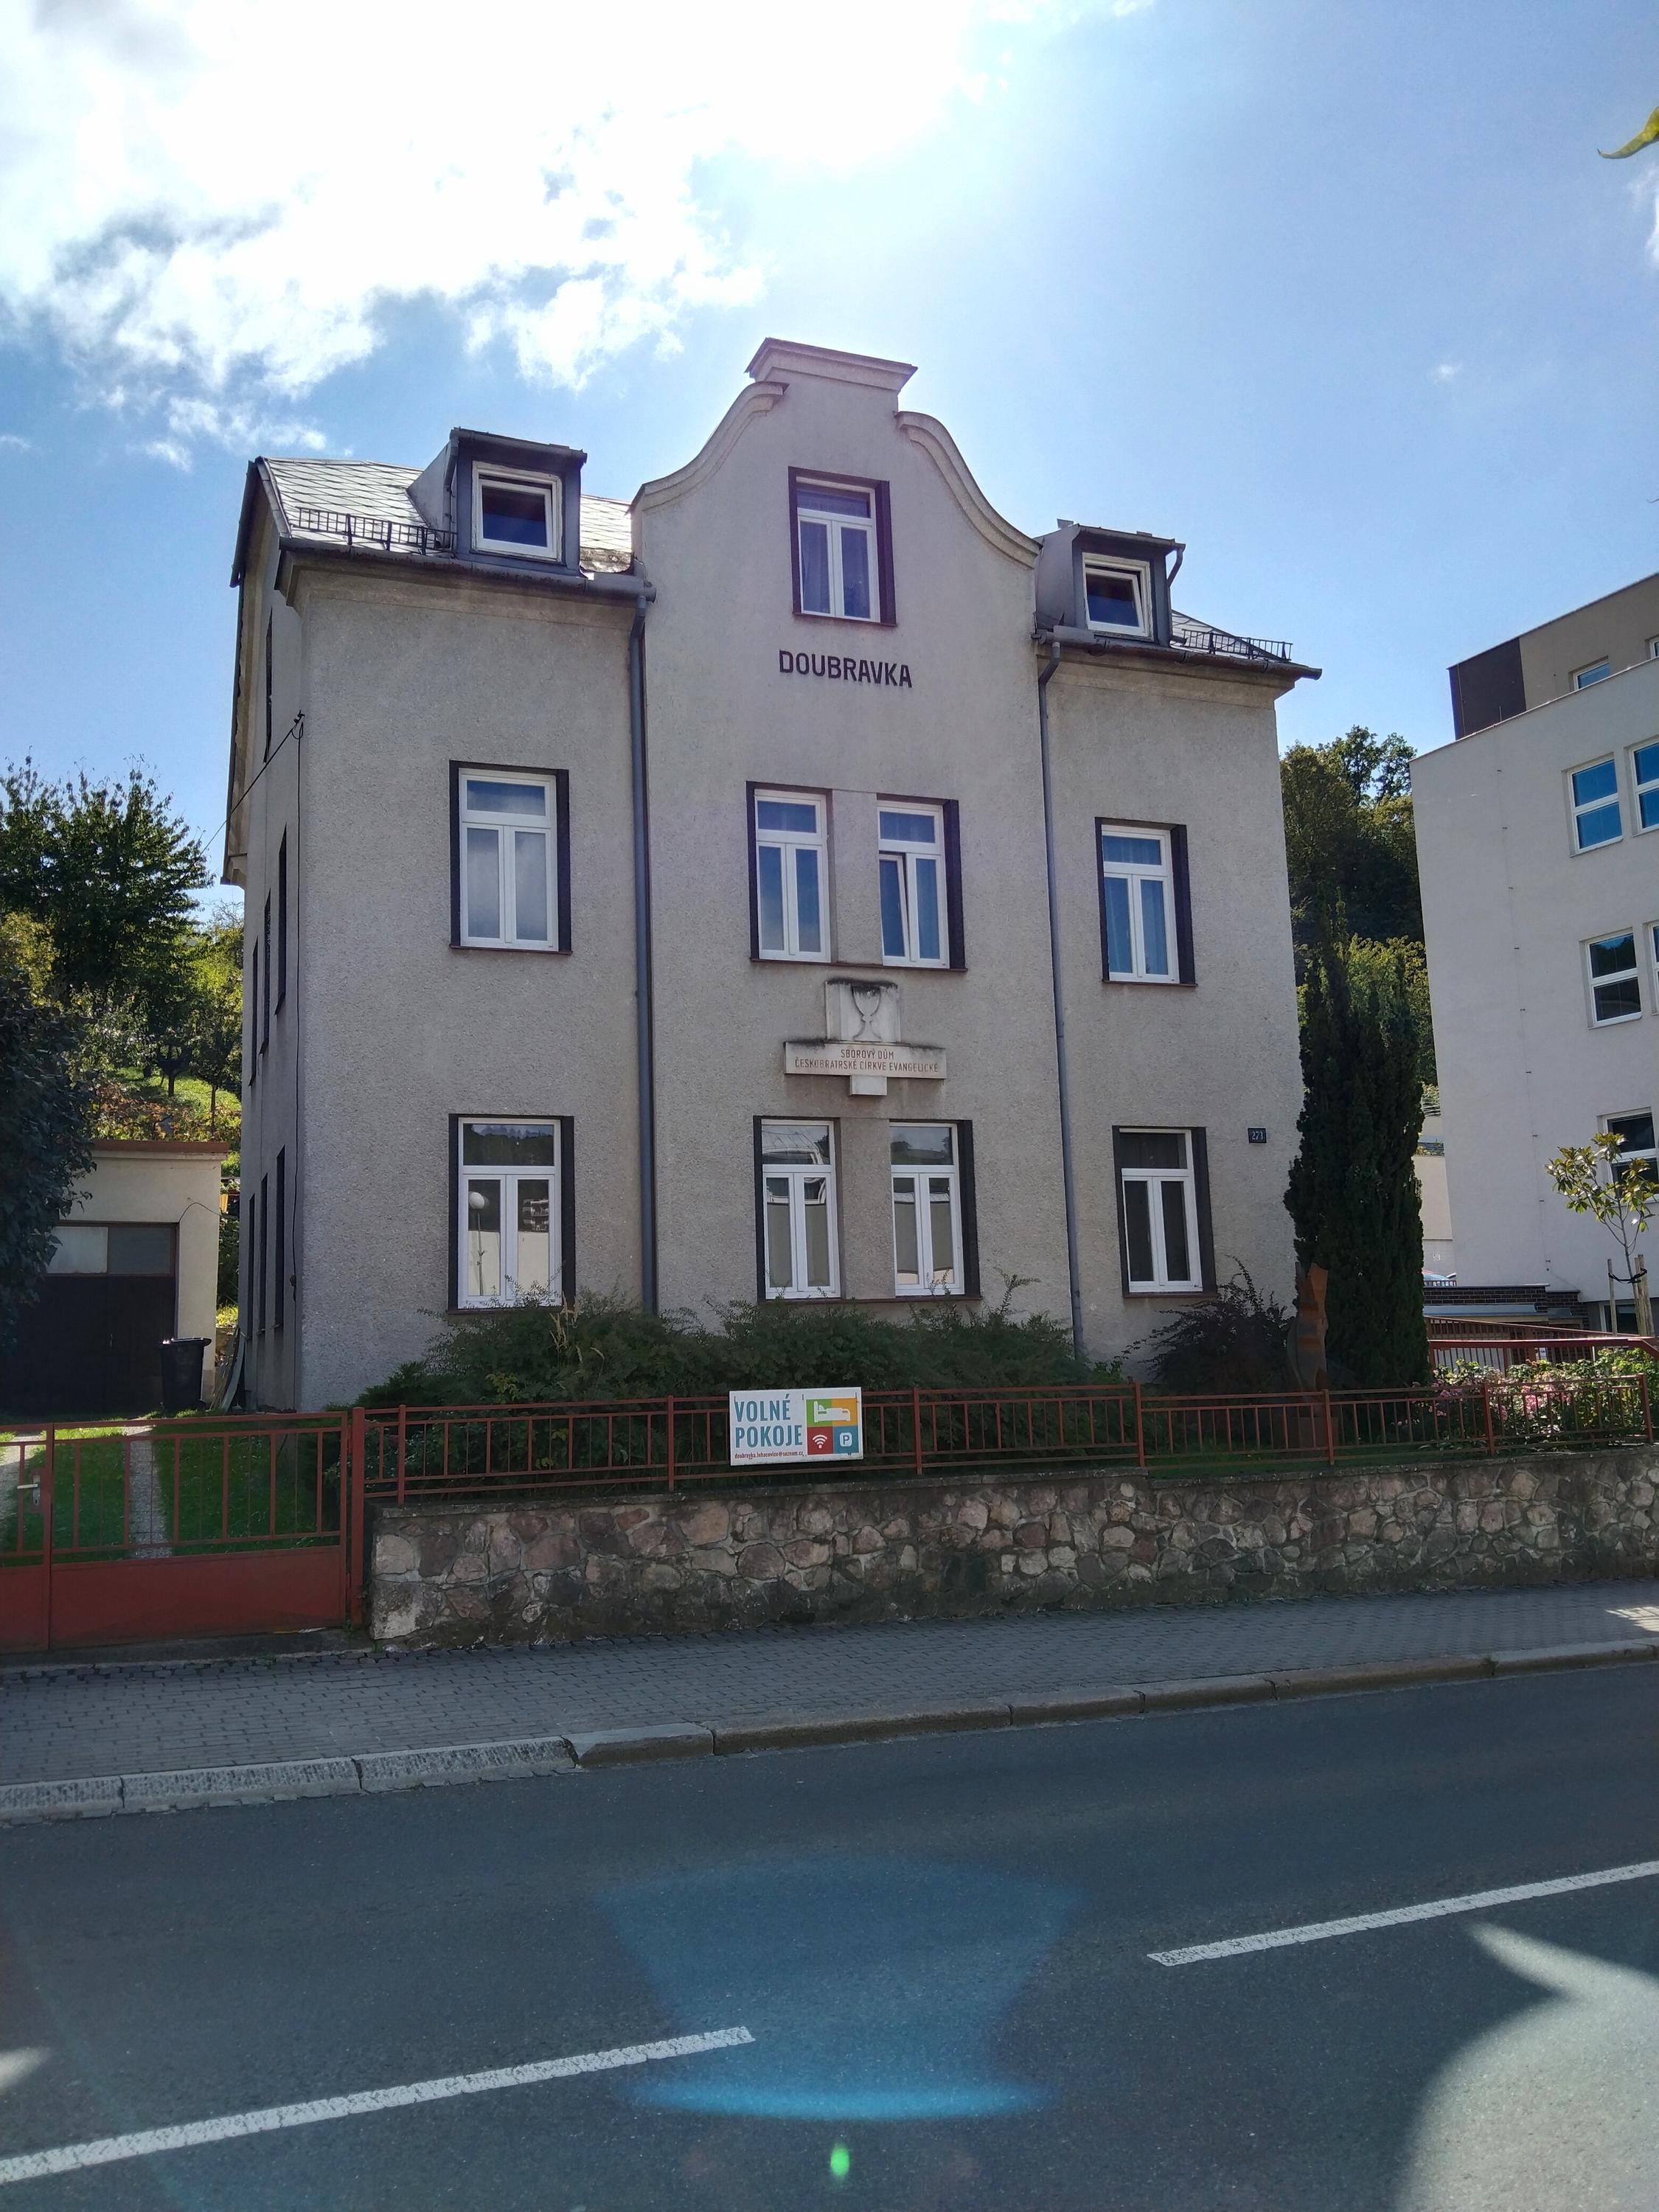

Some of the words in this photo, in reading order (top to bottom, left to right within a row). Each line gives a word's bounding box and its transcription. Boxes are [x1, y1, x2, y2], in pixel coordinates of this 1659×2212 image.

[779, 649, 912, 688] DOUBRAVKA
[795, 1057, 858, 1070] ČESKOBRATRSKÉ
[859, 1060, 886, 1071] CÍRKVE
[889, 1062, 939, 1073] EVANGELICKÉ
[841, 1048, 875, 1060] SBOROVÝ
[877, 1048, 894, 1060] DŮM
[734, 1394, 791, 1422] VOLNÉ
[735, 1425, 803, 1448] POKOJE
